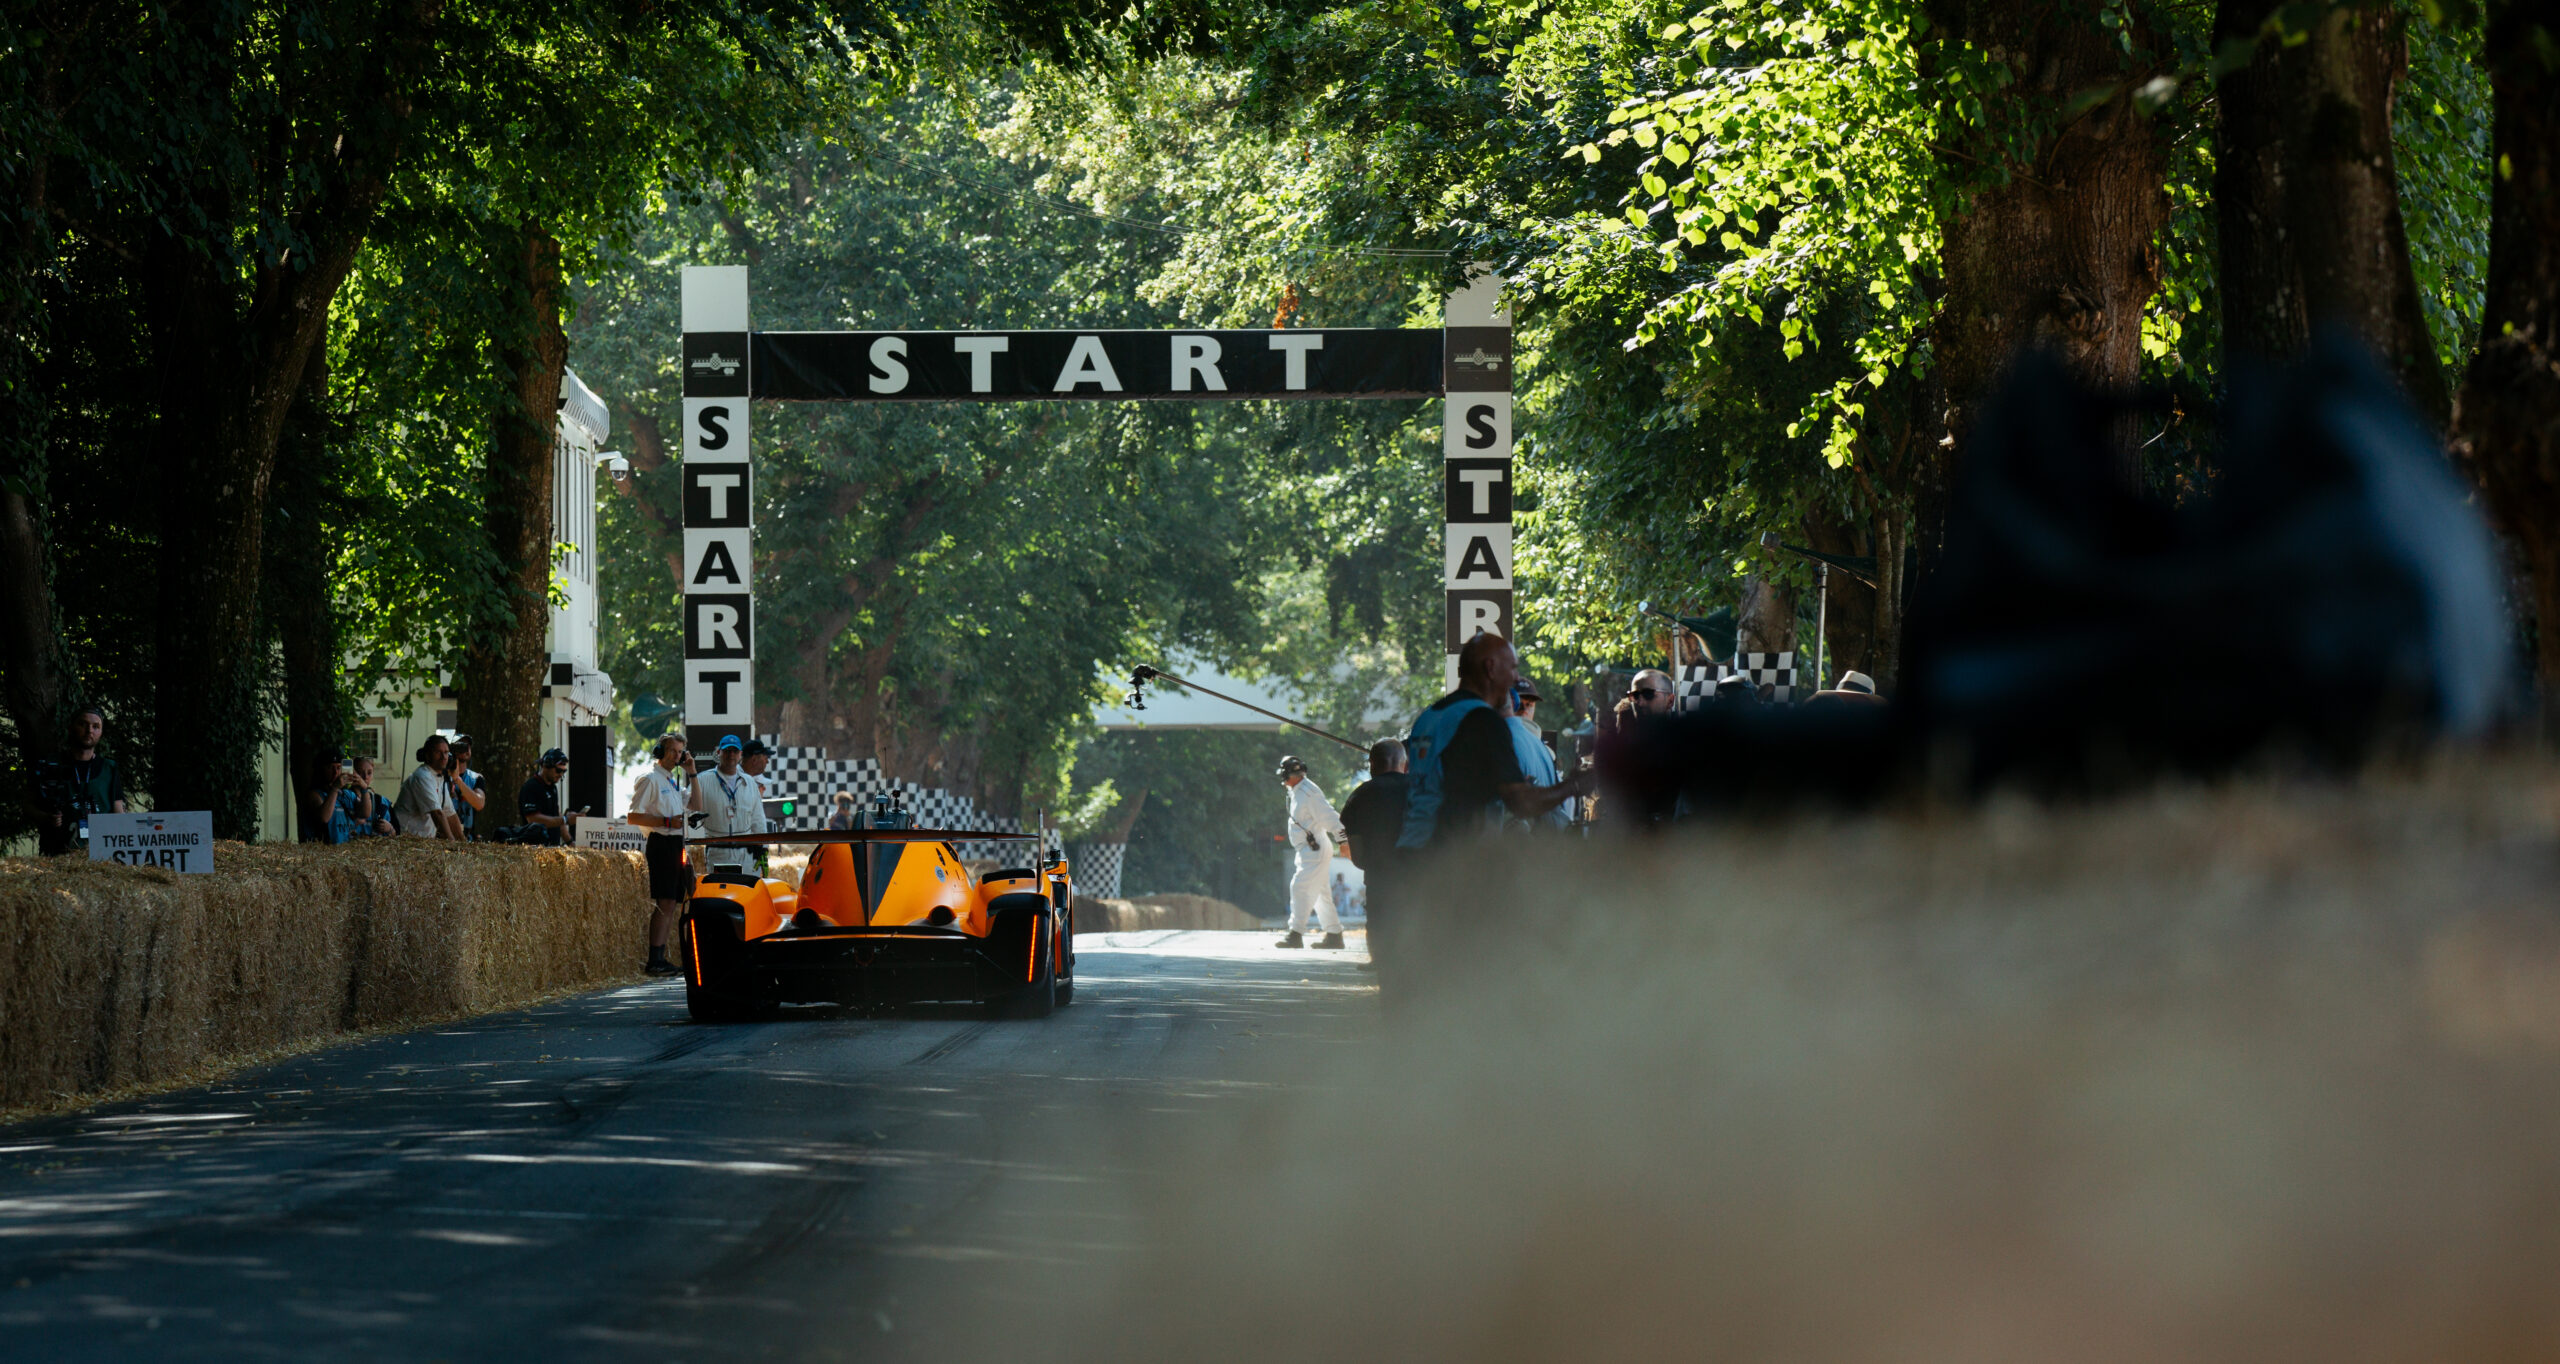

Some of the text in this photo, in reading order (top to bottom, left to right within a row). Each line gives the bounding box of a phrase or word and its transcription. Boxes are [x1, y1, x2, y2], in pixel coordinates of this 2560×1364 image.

[869, 334, 1323, 394] START
[692, 406, 743, 714] START
[1455, 404, 1505, 678] STAR
[102, 833, 199, 847] TYRE WARMING
[585, 831, 605, 840] TYRE
[112, 849, 190, 872] START
